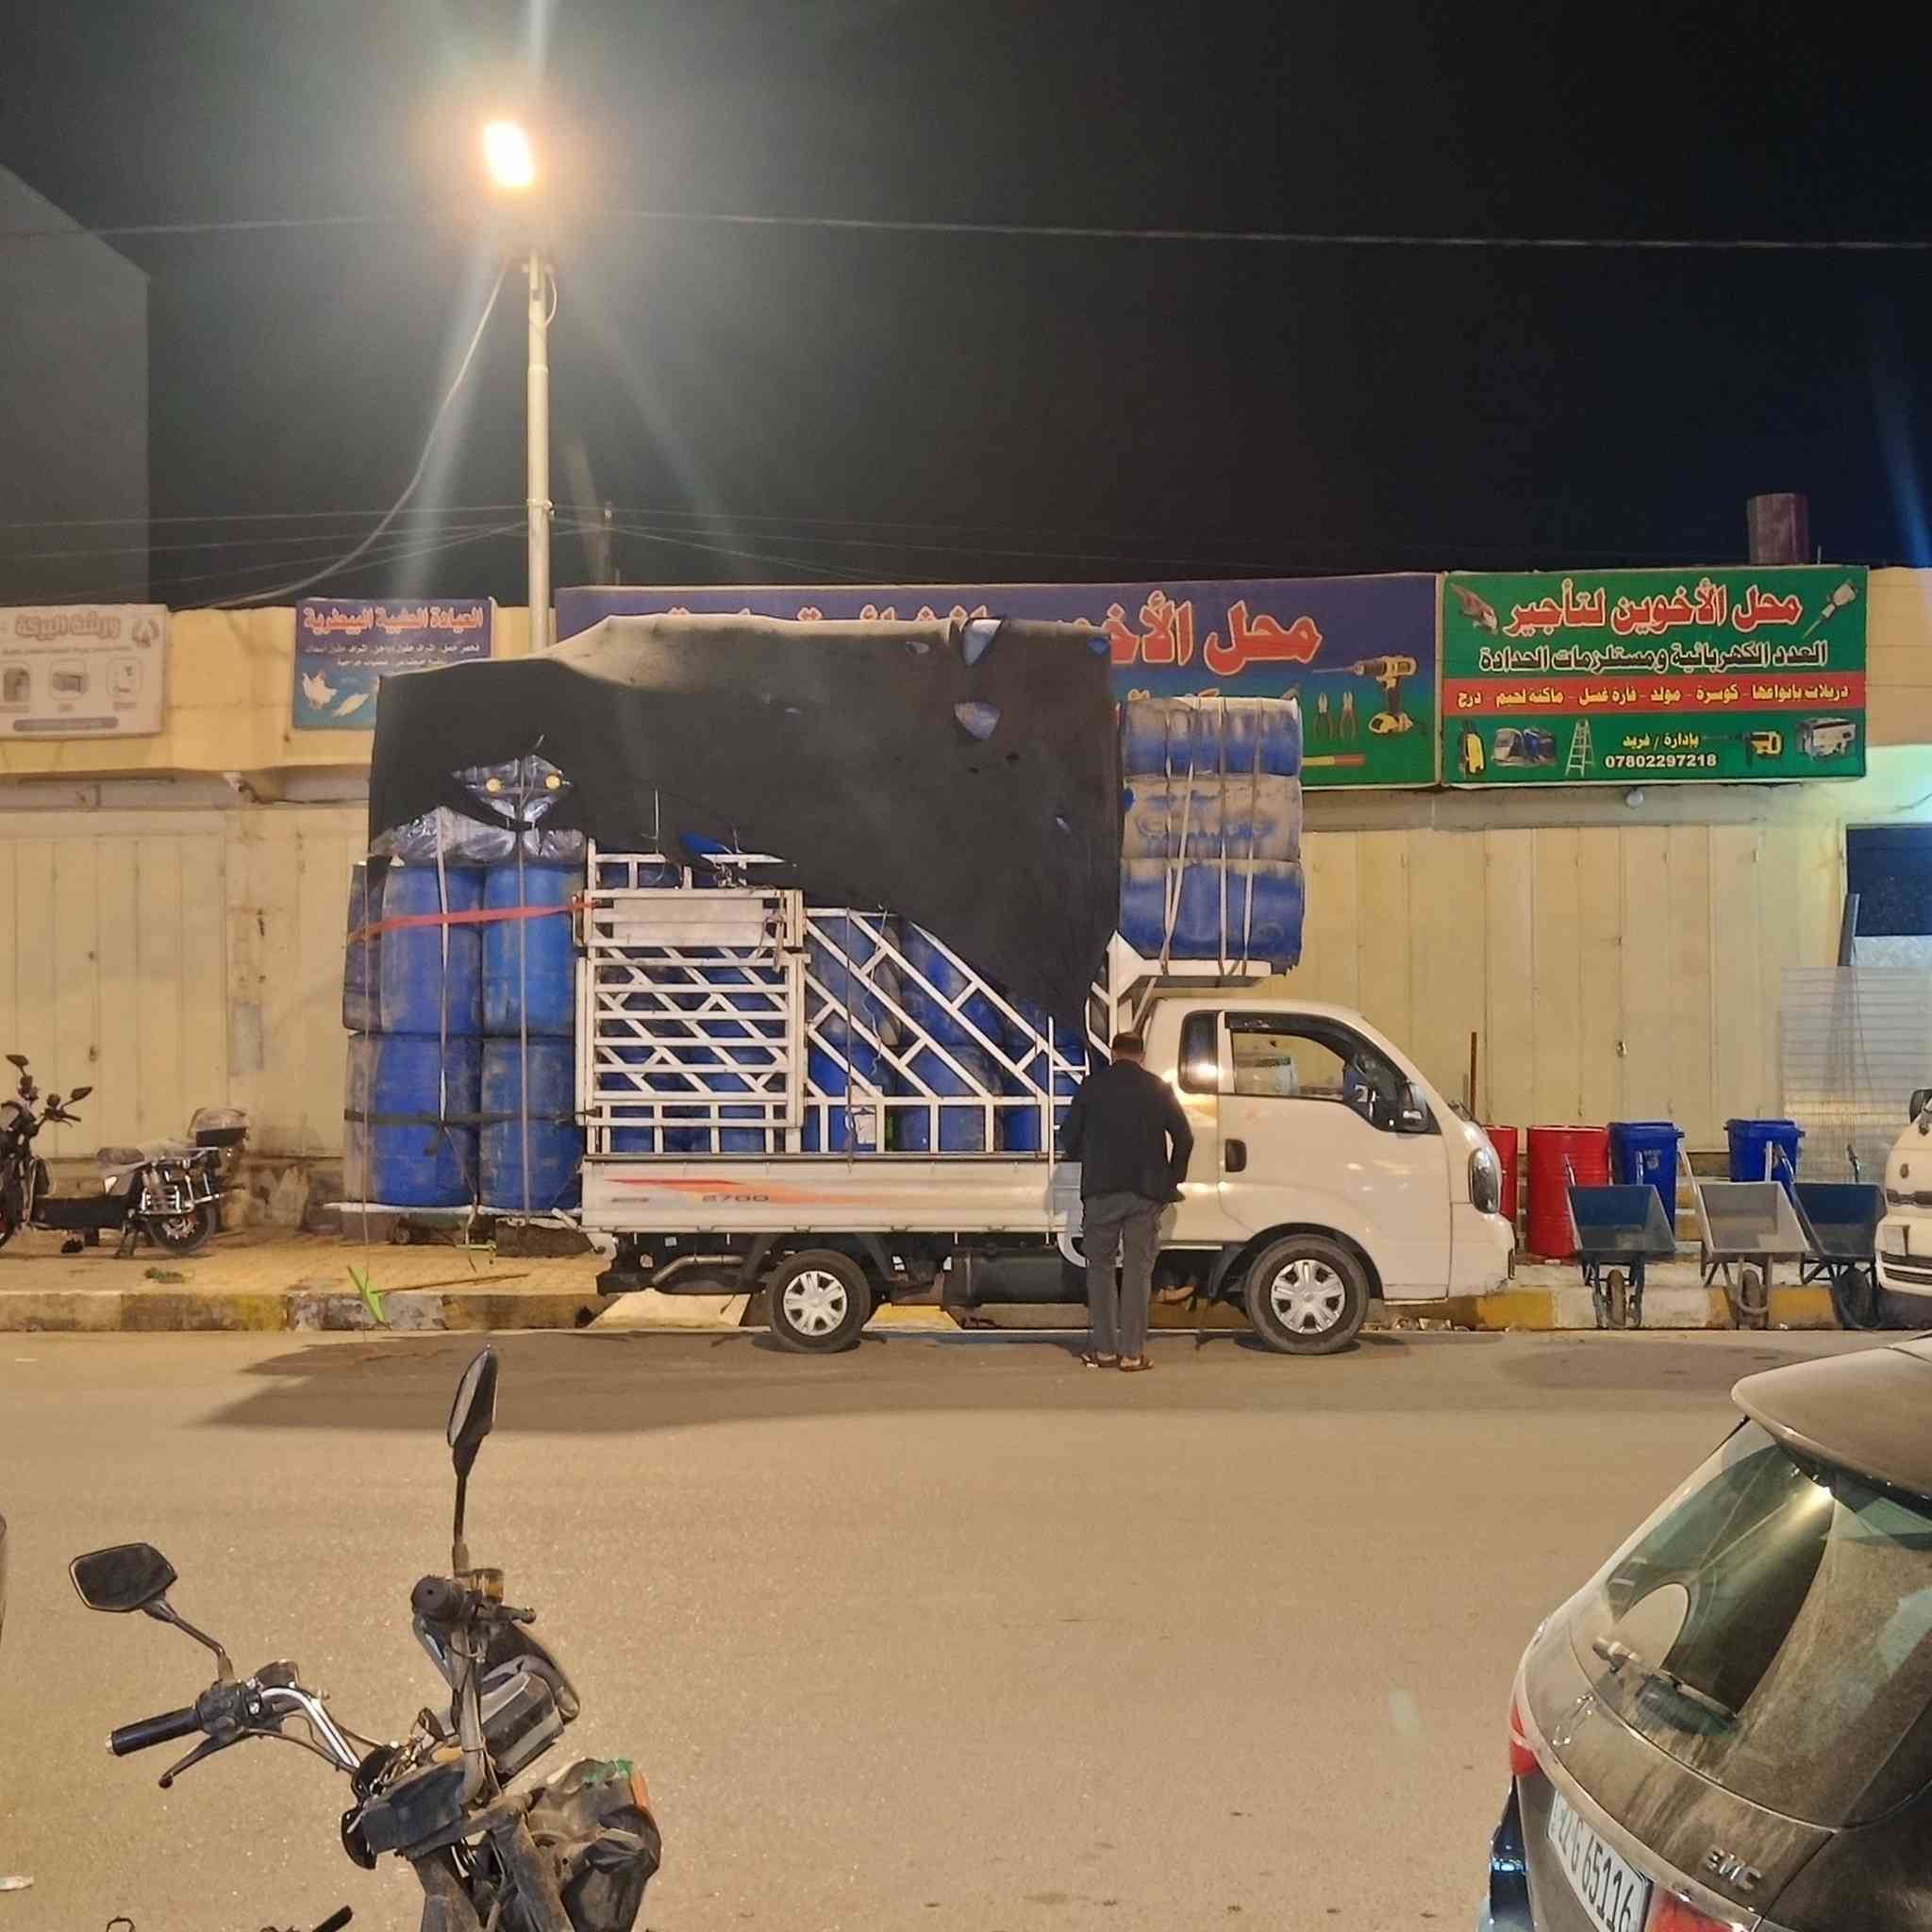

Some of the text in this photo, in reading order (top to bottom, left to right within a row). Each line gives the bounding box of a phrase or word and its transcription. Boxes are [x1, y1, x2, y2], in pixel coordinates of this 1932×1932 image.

[303, 606, 484, 636] العيادة الطبية البيطرية
[1503, 576, 1803, 637] محل الأخوين لتأجير
[1100, 590, 1323, 676] محل الأخ
[1478, 639, 1828, 675] العدد الكهربائية ومستلزمات الحدادة
[1457, 691, 1482, 708] درج
[1651, 686, 1682, 705] مولد
[1605, 754, 1717, 769] 07802297218
[1582, 1833, 1635, 1932] 65116
